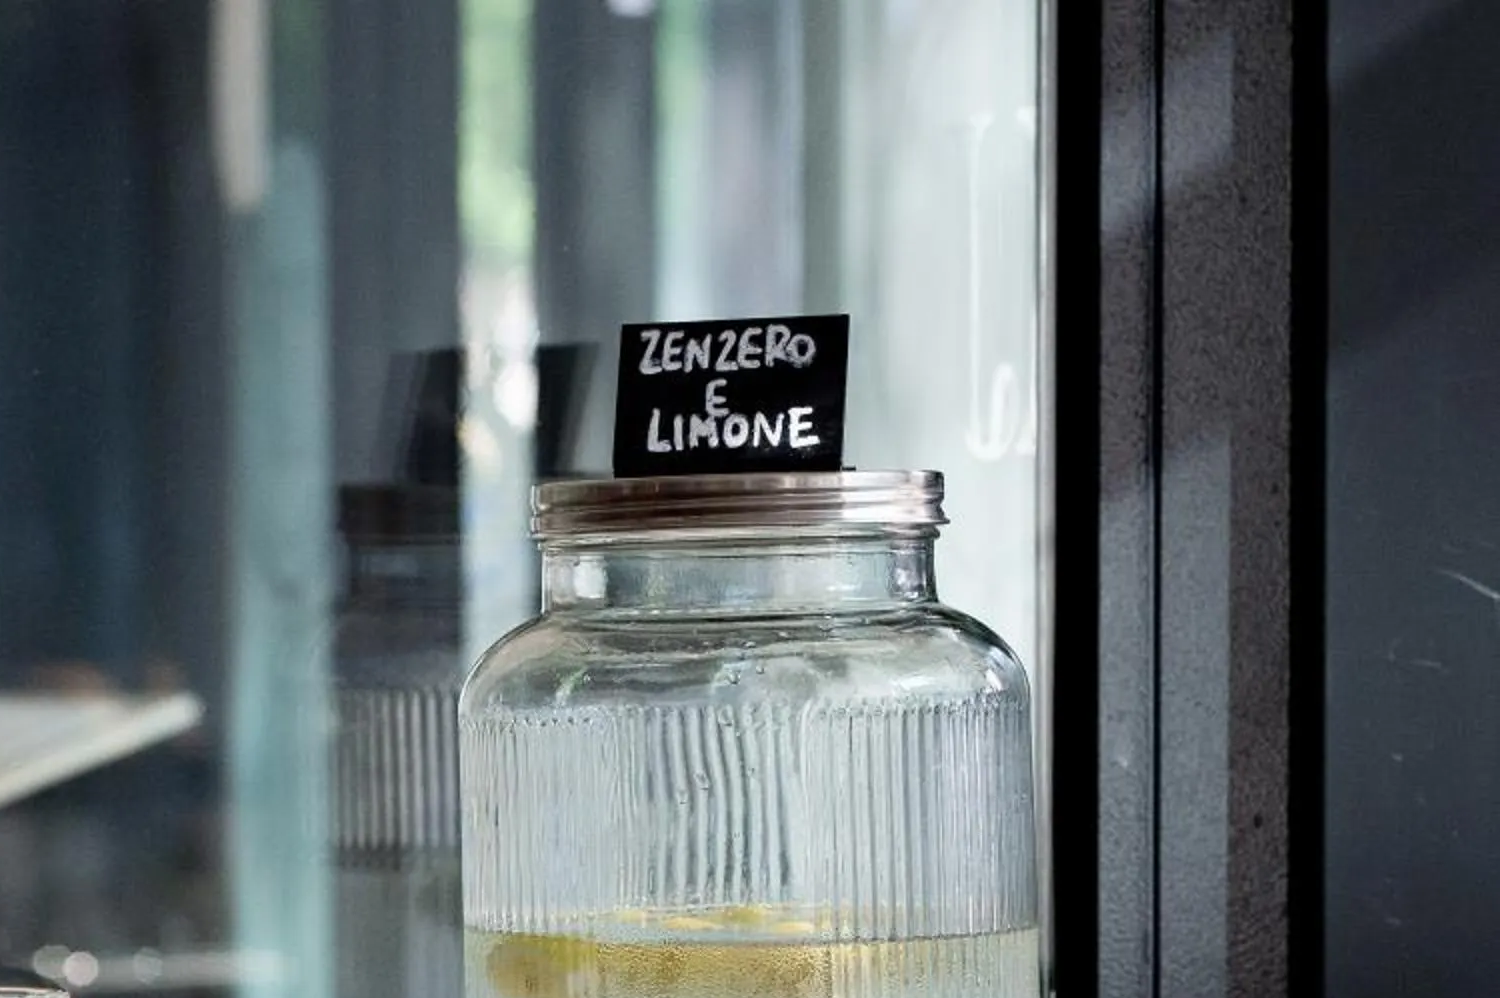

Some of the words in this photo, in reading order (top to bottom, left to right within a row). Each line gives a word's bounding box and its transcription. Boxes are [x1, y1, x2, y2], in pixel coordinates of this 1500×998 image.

[639, 324, 816, 374] ZENZERO
[705, 378, 729, 417] E
[647, 406, 820, 452] LIMONE
